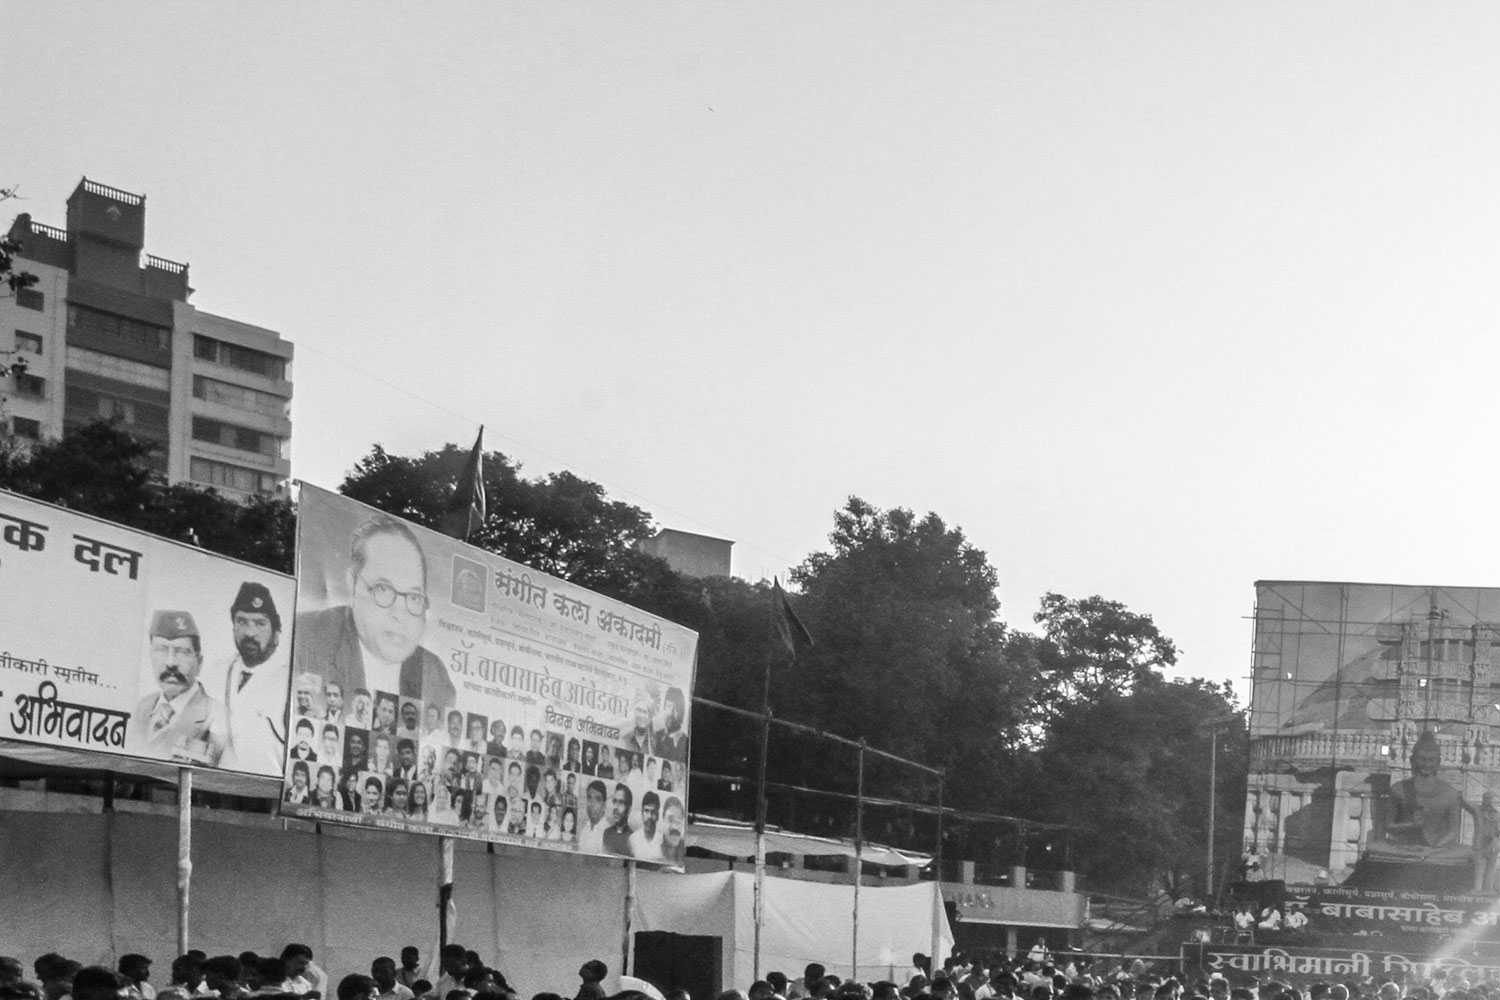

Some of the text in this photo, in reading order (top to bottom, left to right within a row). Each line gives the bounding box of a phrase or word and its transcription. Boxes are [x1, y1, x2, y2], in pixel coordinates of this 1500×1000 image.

[73, 534, 143, 580] दल
[495, 567, 548, 610] संगीत
[553, 592, 591, 625] कला
[450, 639, 475, 677] डॉ.
[10, 680, 131, 748] अभिवादन
[1320, 901, 1466, 926] बाबासाहेब
[1208, 948, 1372, 977] स्वाभिमानी
